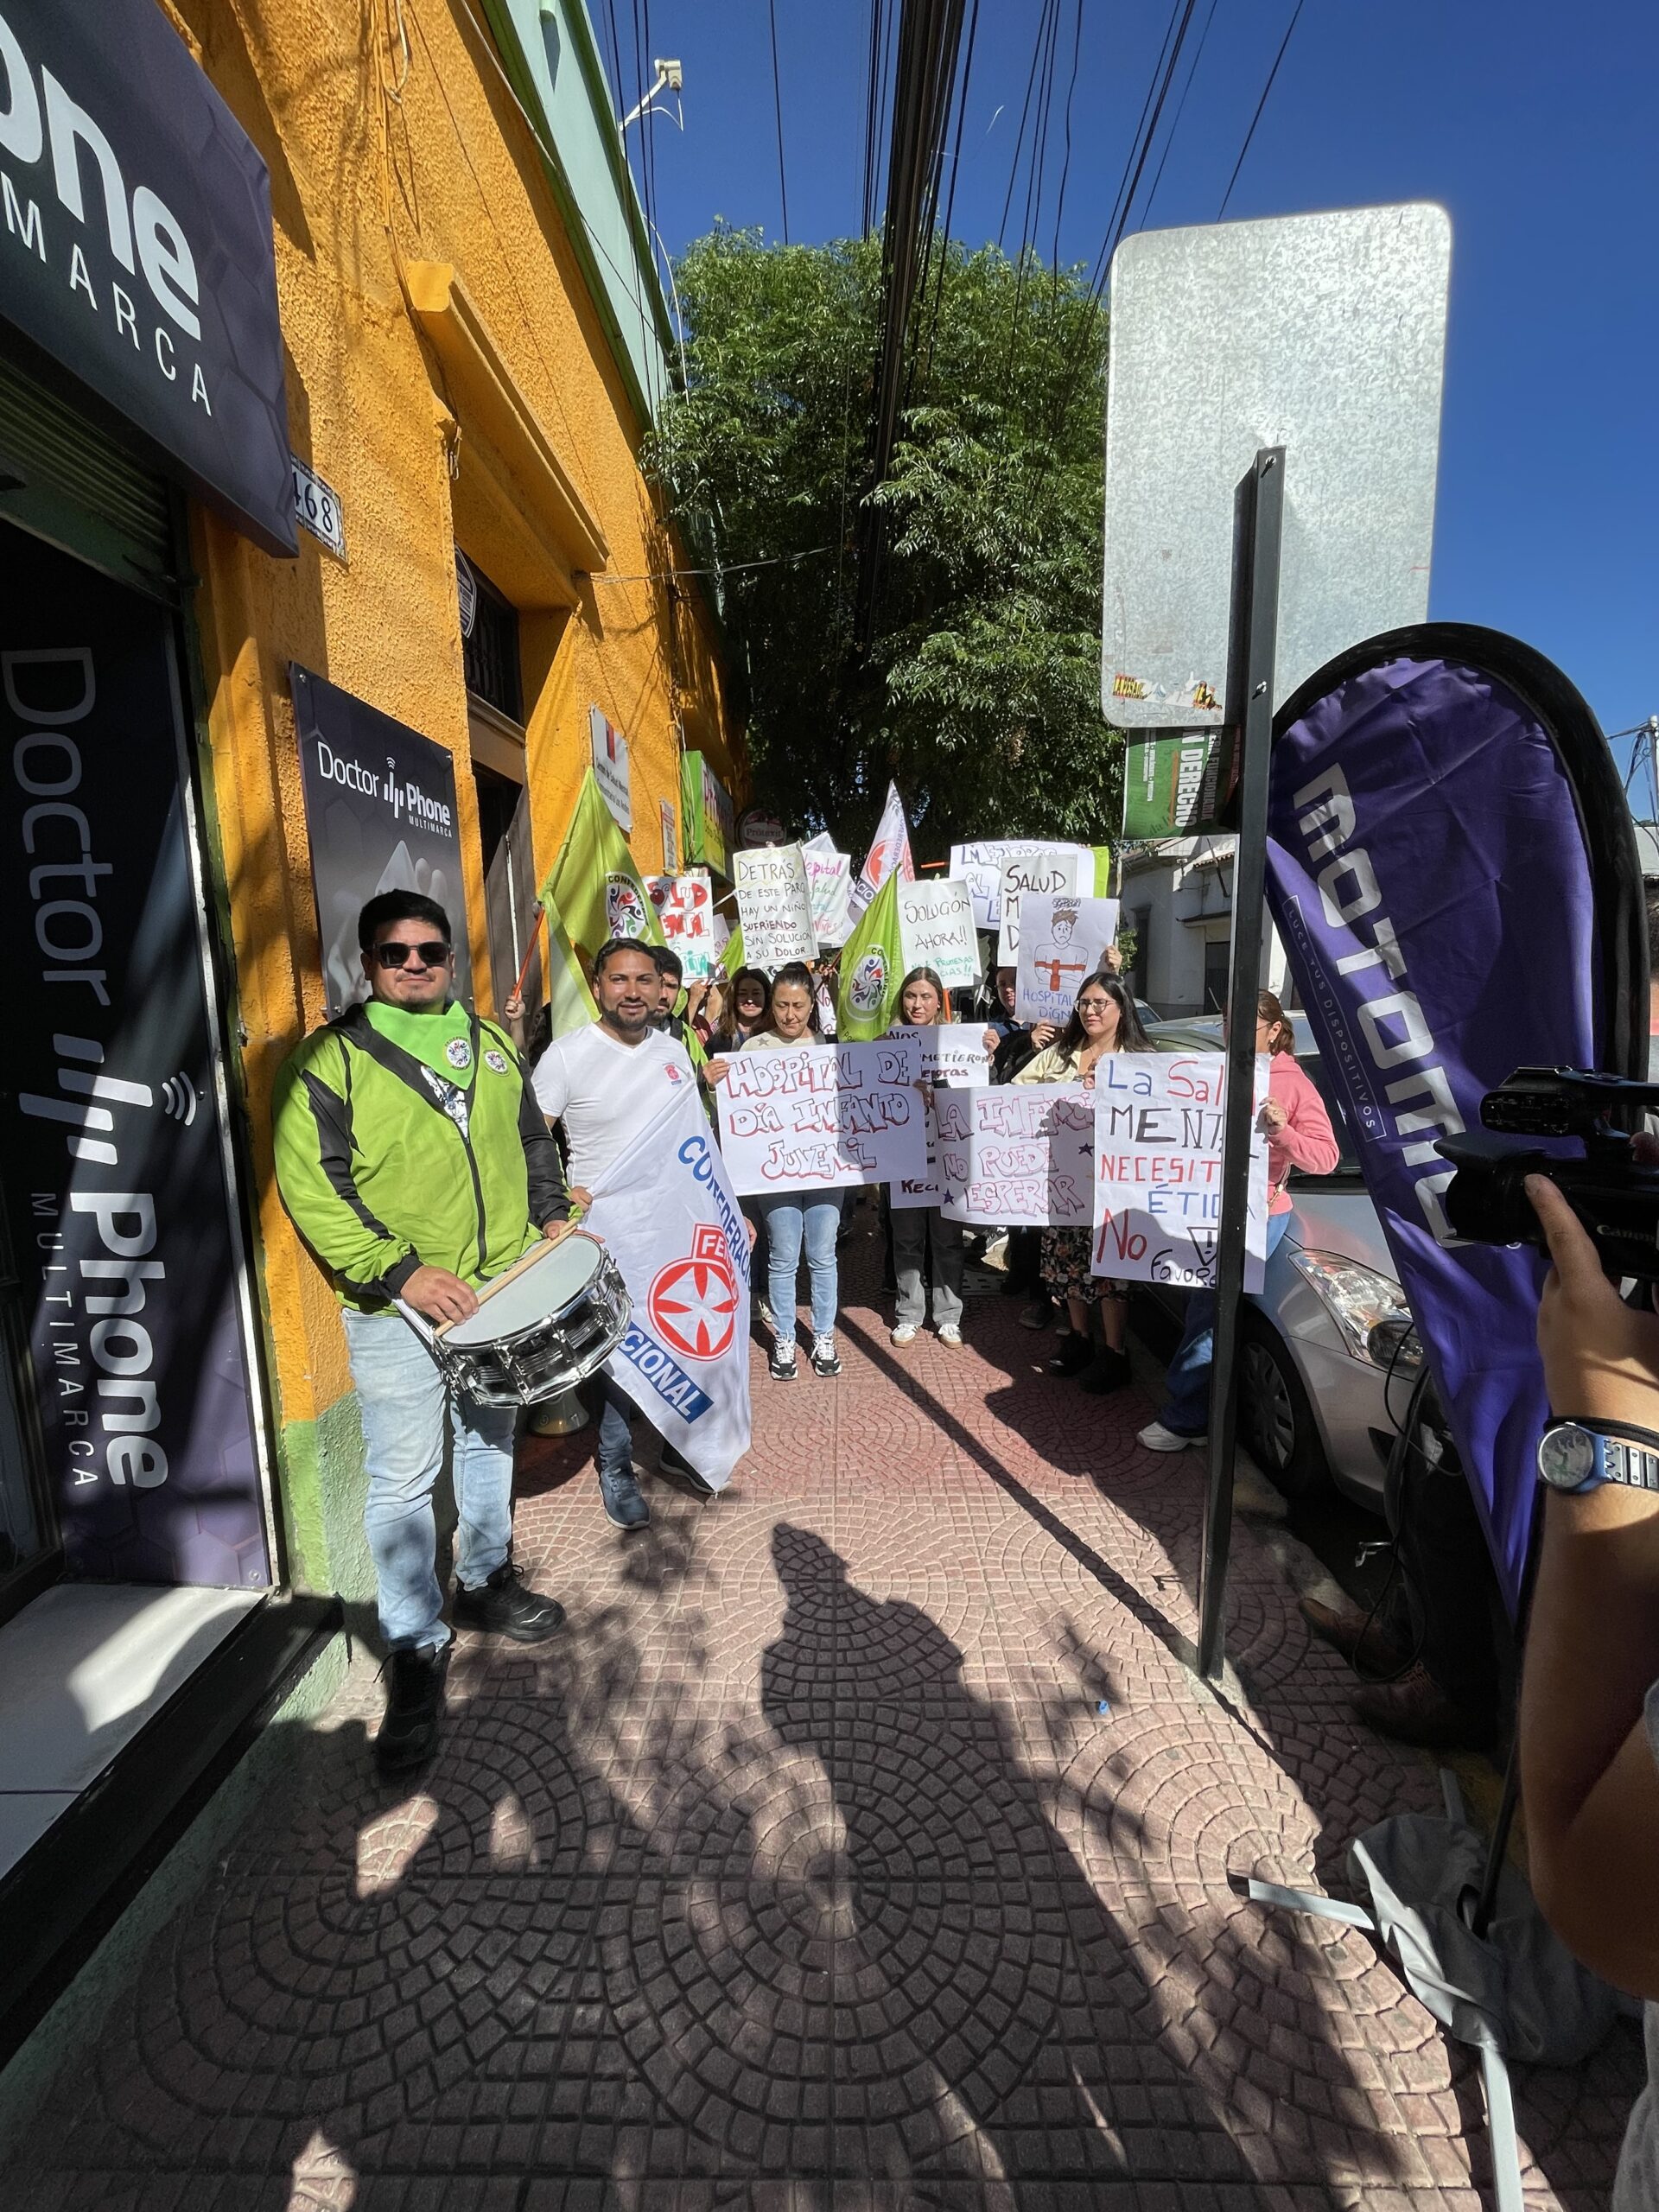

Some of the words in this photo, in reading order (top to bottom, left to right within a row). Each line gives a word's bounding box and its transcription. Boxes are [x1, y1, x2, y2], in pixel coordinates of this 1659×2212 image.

[318, 741, 379, 797] Doctor
[406, 782, 451, 826] Phone
[1175, 748, 1204, 827] DERECHO
[409, 815, 453, 838] MULTIMARCA
[738, 859, 795, 881] DETRÁS
[1004, 864, 1067, 893] SALUD
[738, 889, 752, 899] DE
[758, 888, 780, 898] ESTE
[784, 882, 804, 898] PARO
[659, 912, 711, 939] ENTAL
[741, 906, 760, 920] HAY
[747, 952, 752, 961] A
[755, 950, 769, 960] SU
[774, 946, 805, 958] DOLOR
[1310, 959, 1325, 991] TUS
[1323, 999, 1376, 1128] DISPOSITIVOS
[2, 646, 113, 1007] Doctor
[70, 1192, 168, 1489] Phone
[877, 1051, 910, 1086] DE
[1108, 1059, 1153, 1096] La
[1166, 1060, 1225, 1107] Sal
[792, 1092, 910, 1135] INFANTO
[935, 1103, 975, 1141] LA
[1109, 1104, 1224, 1150] MENT
[978, 1142, 1059, 1178] PUEDE
[1100, 1154, 1222, 1183] NECESIT
[964, 1175, 1085, 1217] ESPERAR
[31, 1193, 99, 1486] MULTIMARCA
